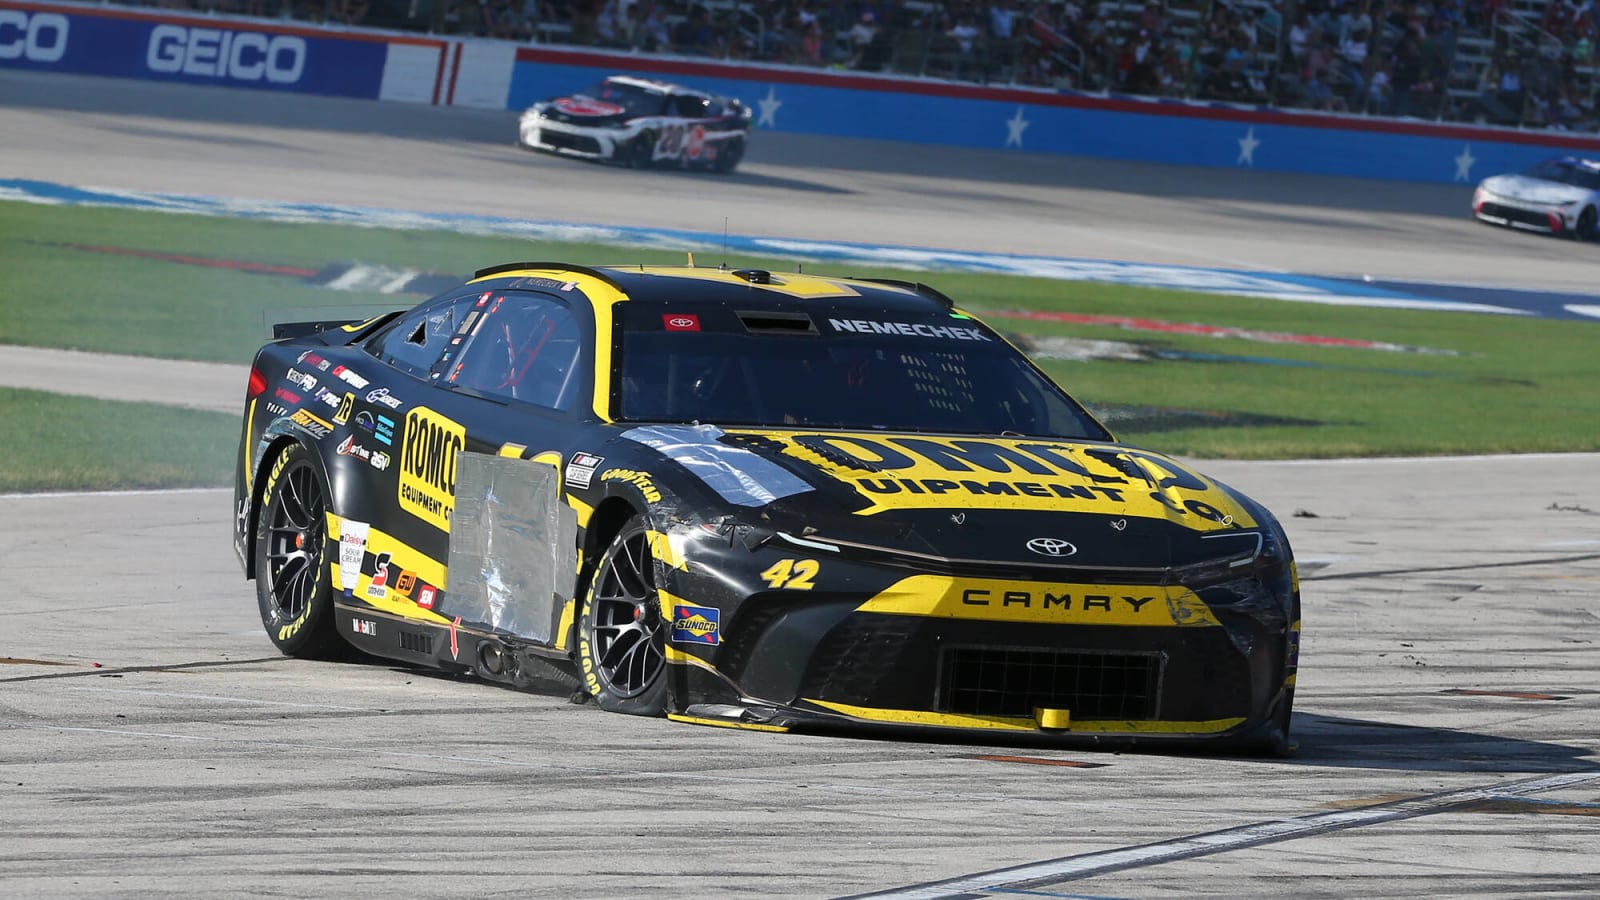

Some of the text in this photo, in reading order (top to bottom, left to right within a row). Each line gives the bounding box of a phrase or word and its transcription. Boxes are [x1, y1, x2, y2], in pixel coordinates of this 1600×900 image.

[147, 24, 306, 83] GEICO
[828, 318, 993, 343] NEMECHEK
[404, 412, 462, 497] ROMCO
[790, 434, 1208, 490] OMCO
[263, 447, 289, 507] EAGLE
[601, 468, 664, 504] GOODYEAR
[855, 478, 1125, 503] UIPMENT
[402, 483, 442, 517] EQUIPMENT
[344, 533, 364, 547] Daisy
[760, 559, 820, 590] 42
[962, 588, 1157, 612] CAMRY
[676, 620, 716, 632] SUNOCO
